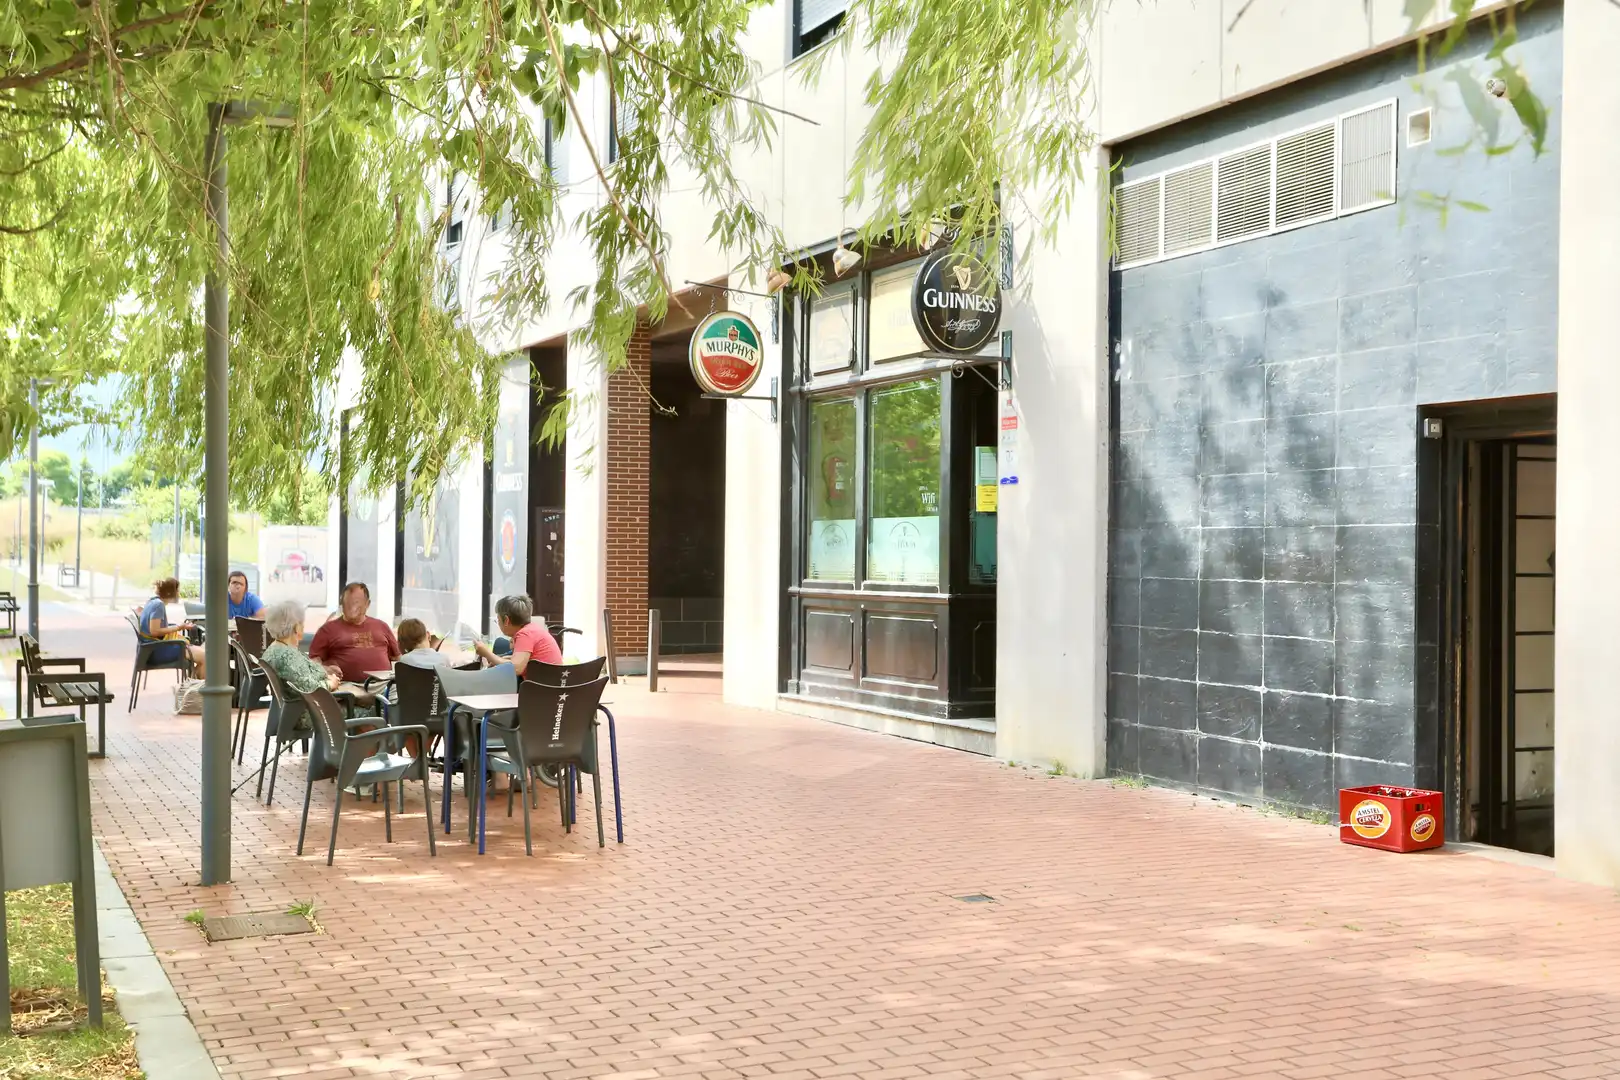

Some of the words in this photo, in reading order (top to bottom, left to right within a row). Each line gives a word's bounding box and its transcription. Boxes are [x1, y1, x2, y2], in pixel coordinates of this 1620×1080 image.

[923, 288, 996, 313] GUINNESS
[921, 492, 936, 504] Wifi
[430, 682, 440, 716] Heineken
[551, 702, 565, 740] Heineken
[1358, 808, 1380, 817] AMSTEL
